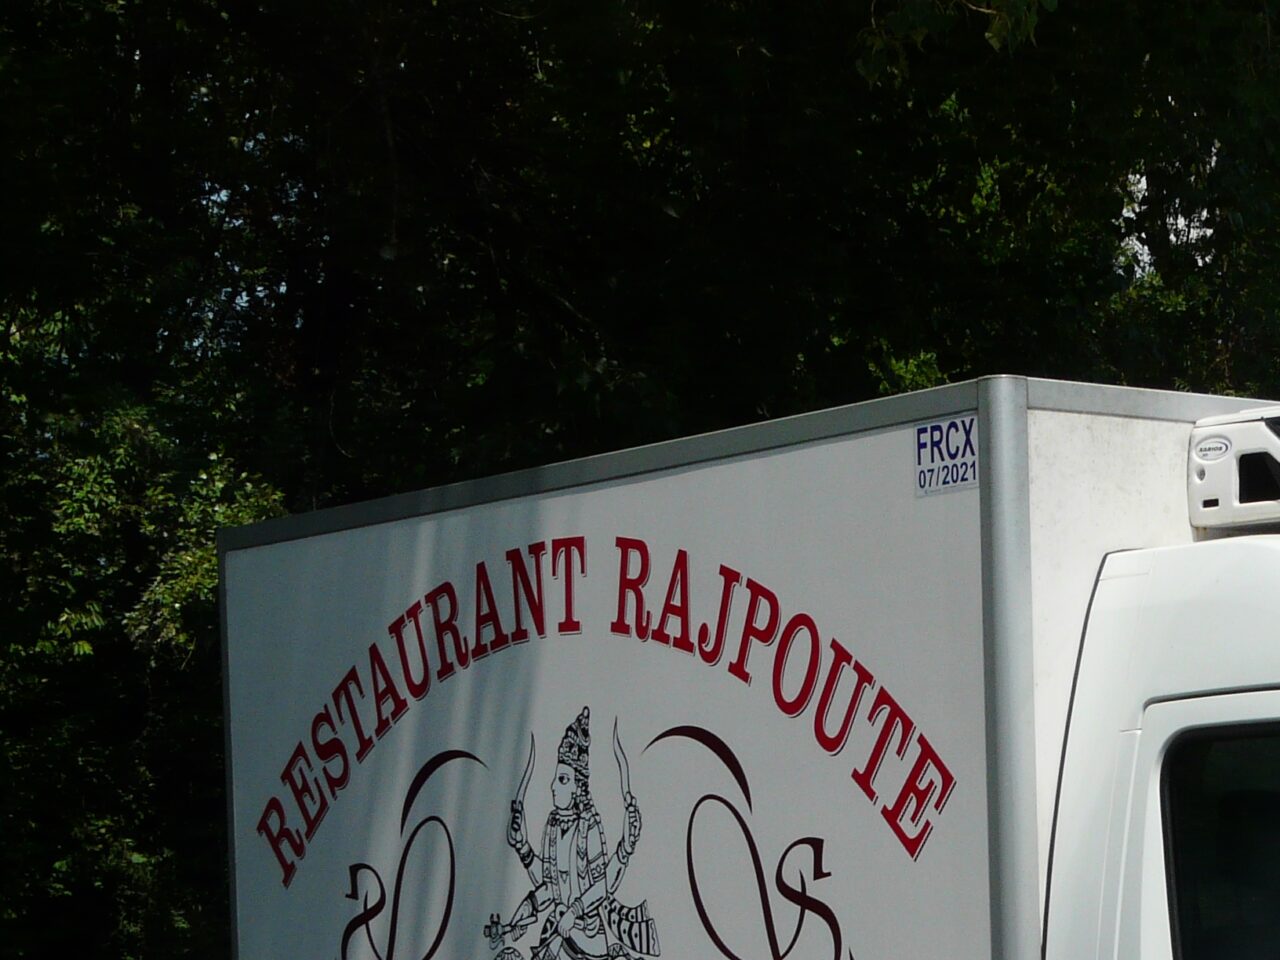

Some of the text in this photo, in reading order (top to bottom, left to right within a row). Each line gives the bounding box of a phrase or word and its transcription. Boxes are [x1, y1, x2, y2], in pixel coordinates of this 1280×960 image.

[917, 418, 976, 466] FRCX
[918, 460, 976, 489] 07/2021
[256, 535, 957, 888] RESTAURANT RAJPOUTE
